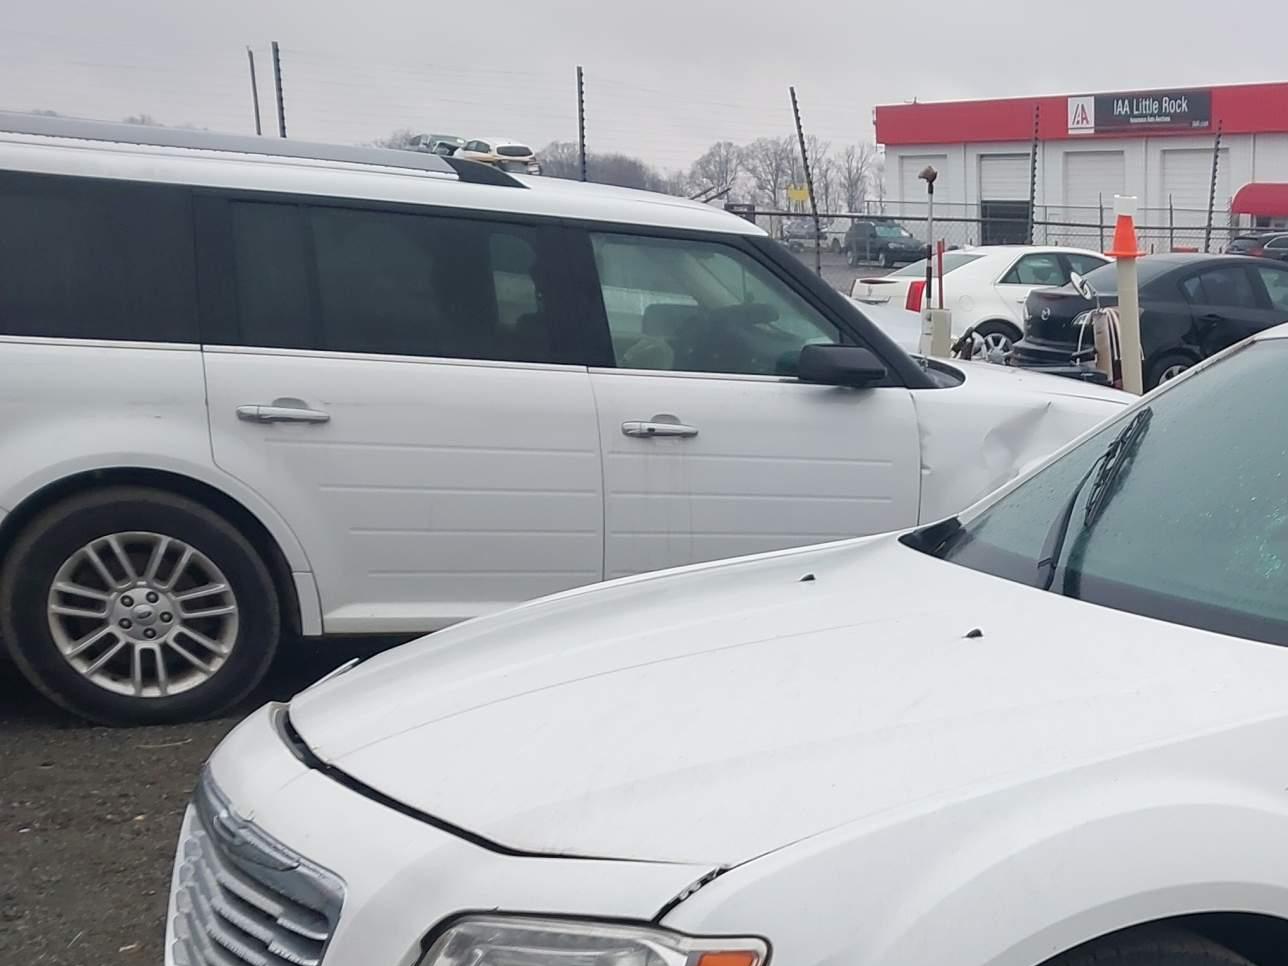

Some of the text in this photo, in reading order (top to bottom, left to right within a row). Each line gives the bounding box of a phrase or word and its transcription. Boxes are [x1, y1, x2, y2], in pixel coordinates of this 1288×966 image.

[1113, 96, 1188, 115] IAA Little Rock
